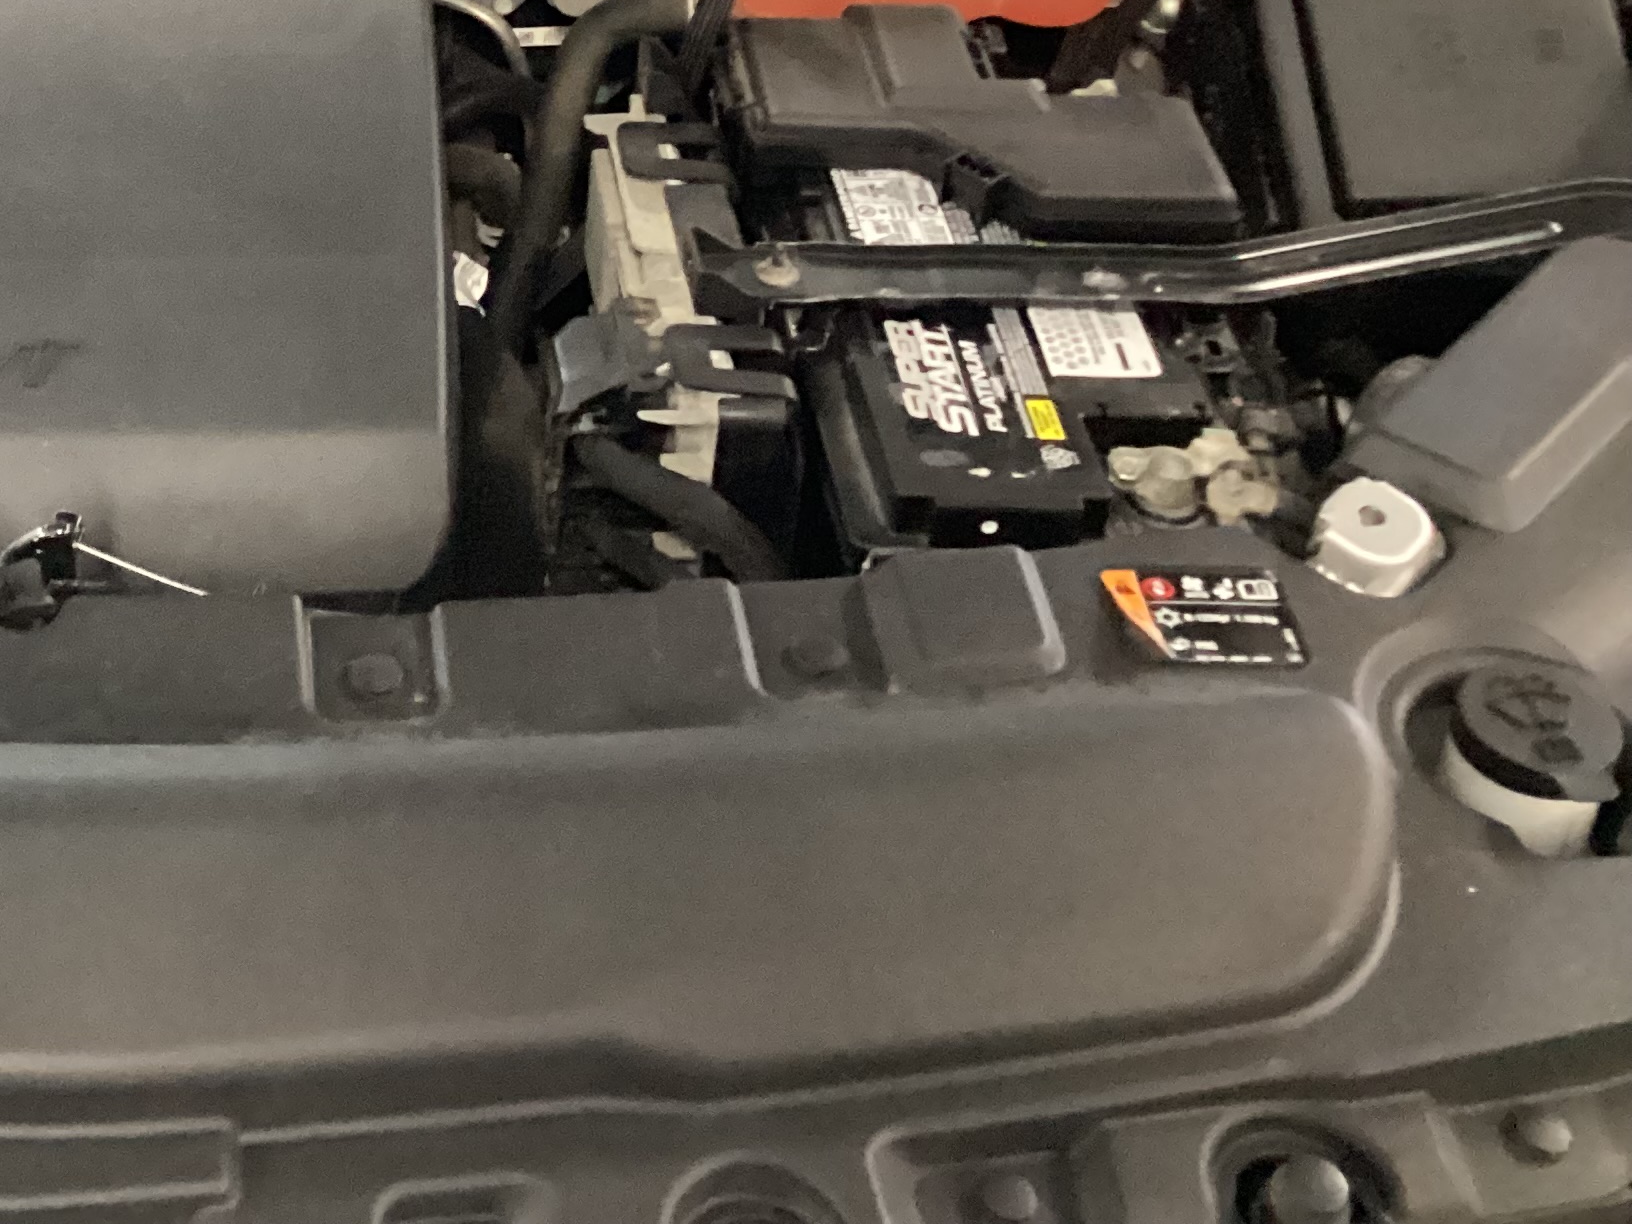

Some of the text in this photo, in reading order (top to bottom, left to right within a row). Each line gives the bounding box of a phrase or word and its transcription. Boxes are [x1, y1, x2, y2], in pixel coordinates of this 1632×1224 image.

[883, 319, 937, 419] SUPER
[913, 319, 979, 437] START
[956, 338, 1008, 432] PLATINUM
